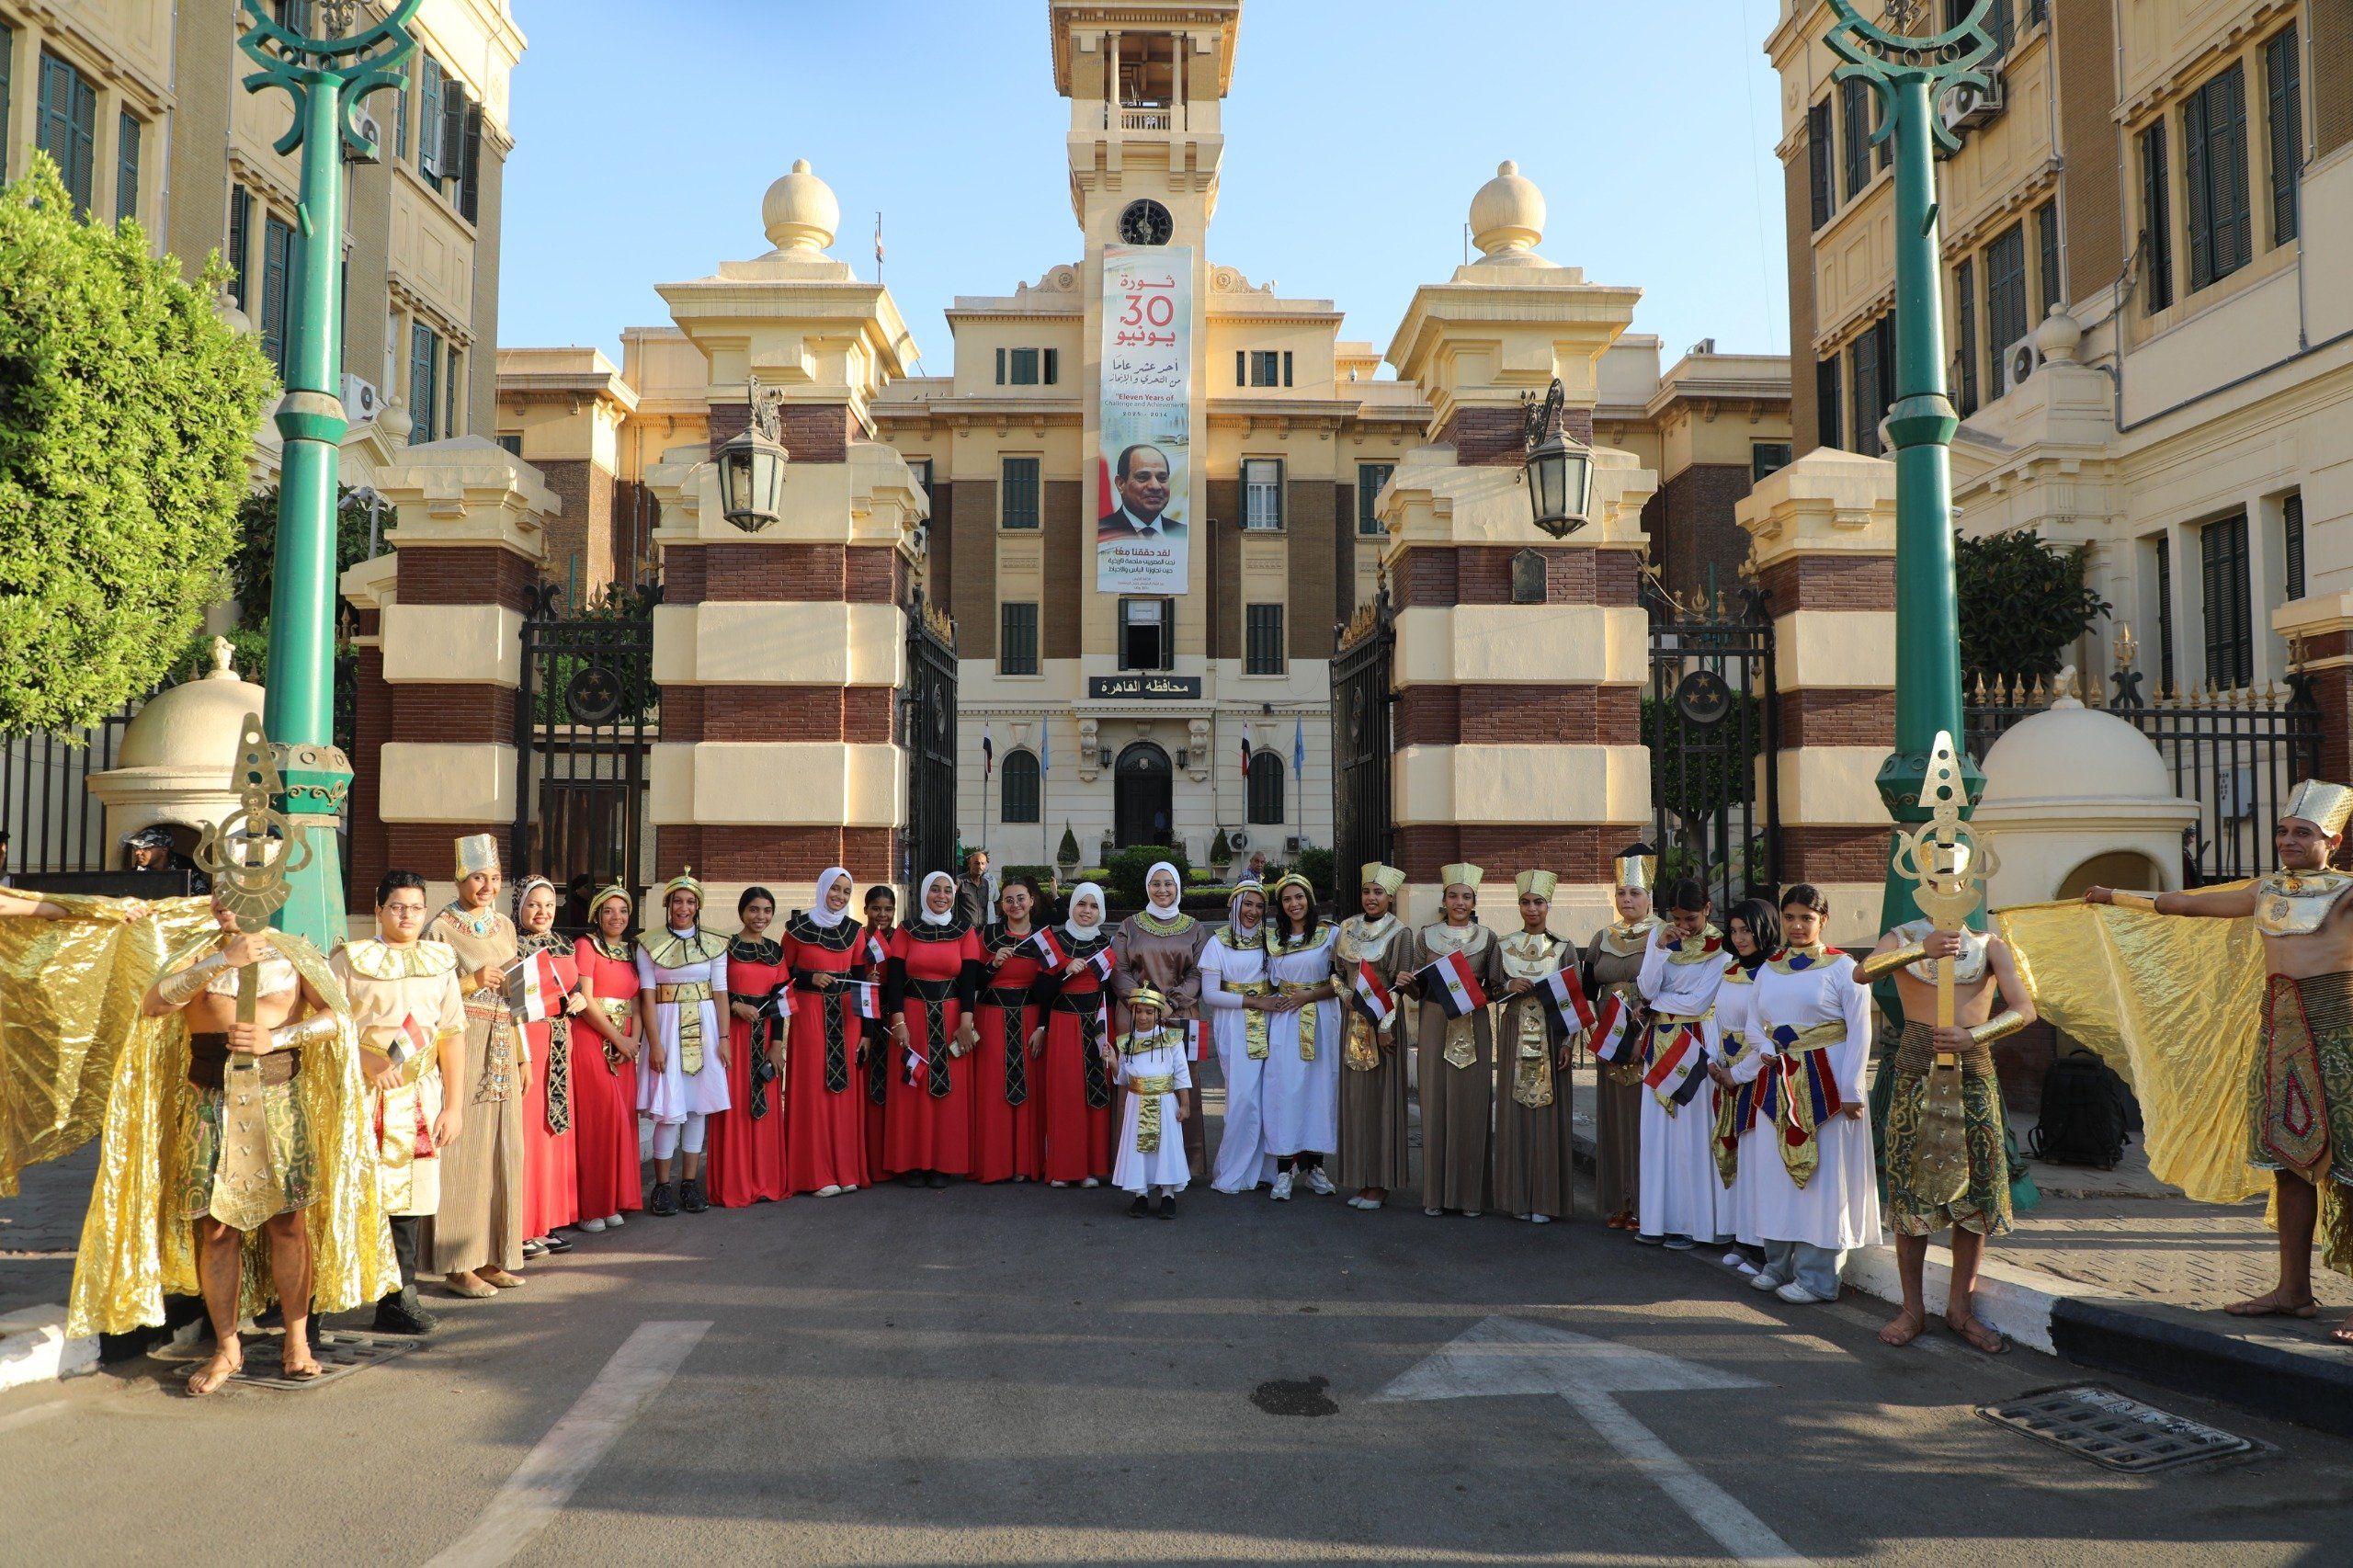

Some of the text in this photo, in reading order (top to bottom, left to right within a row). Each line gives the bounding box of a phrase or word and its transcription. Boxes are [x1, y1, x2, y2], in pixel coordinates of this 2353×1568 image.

[1120, 274, 1176, 290] ثورة
[1120, 295, 1174, 326] 30
[1113, 325, 1176, 347] يونيو
[1134, 362, 1156, 374] عشر
[1145, 393, 1165, 402] Years
[1131, 548, 1155, 556] حققنا
[1157, 549, 1170, 557] لقد
[1101, 679, 1141, 695] القاهرة
